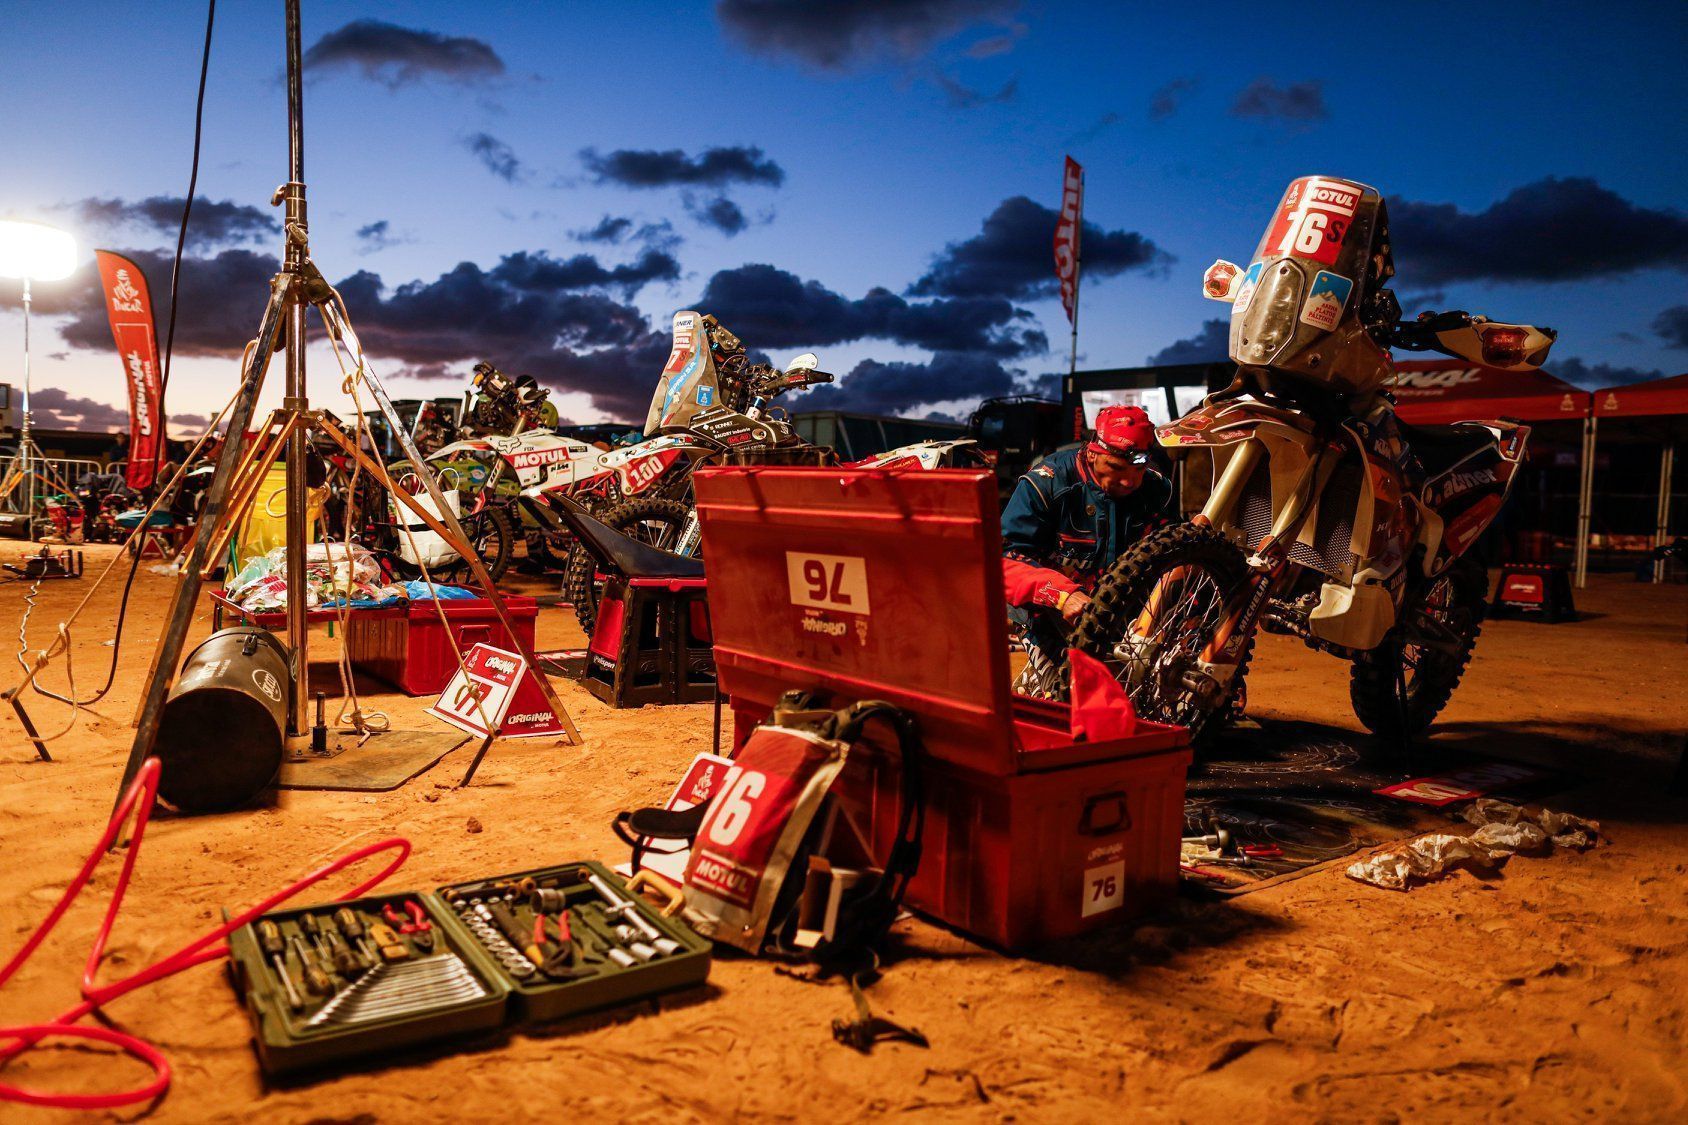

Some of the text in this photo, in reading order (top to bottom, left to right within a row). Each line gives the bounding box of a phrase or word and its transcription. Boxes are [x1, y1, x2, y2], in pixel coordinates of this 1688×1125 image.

[514, 449, 567, 468] MOTUL
[630, 455, 664, 487] 100
[803, 559, 852, 606] 76
[1239, 577, 1269, 633] MICHELIN
[507, 712, 554, 725] ORIGINAL
[696, 859, 748, 892] MOTUL
[1092, 876, 1116, 902] 76
